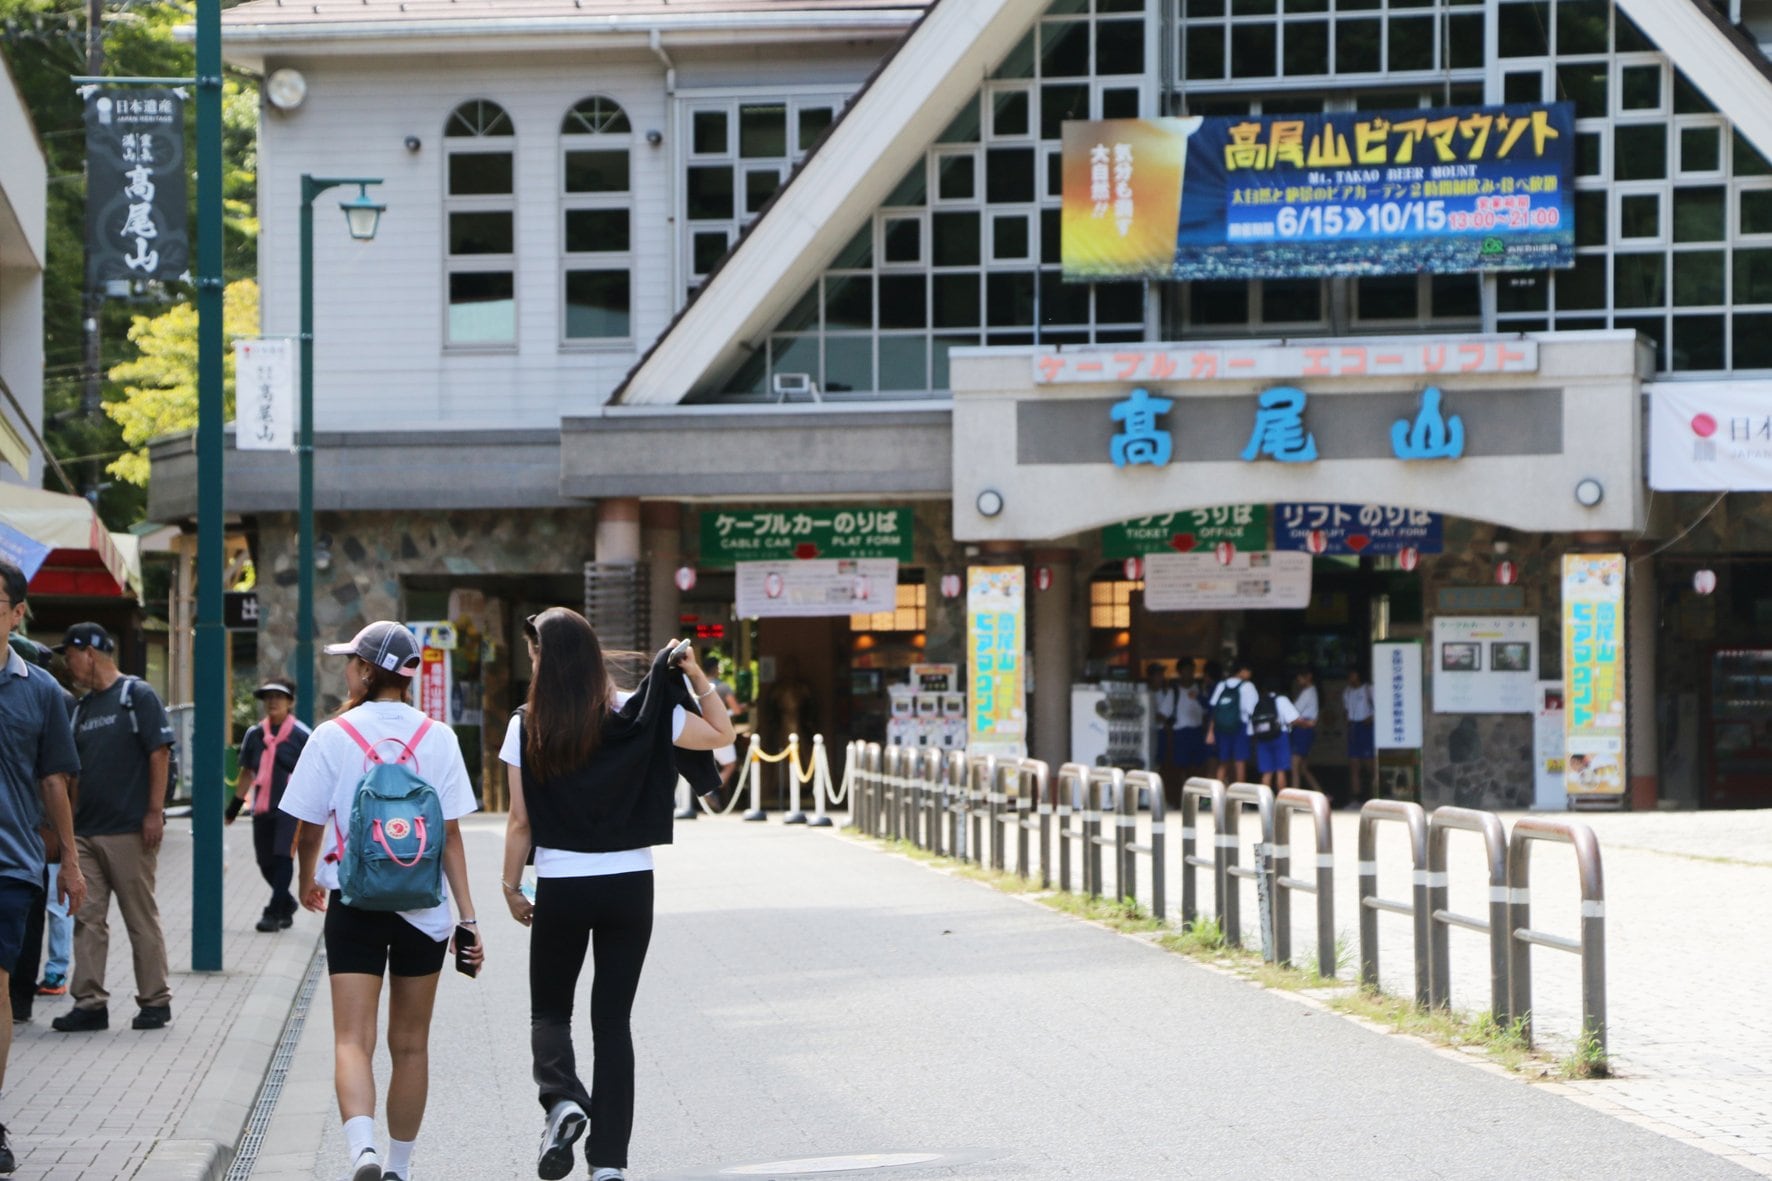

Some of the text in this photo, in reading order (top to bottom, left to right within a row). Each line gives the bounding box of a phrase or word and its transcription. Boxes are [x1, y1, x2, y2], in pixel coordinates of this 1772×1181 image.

[116, 99, 173, 115] 日本遺産
[1224, 111, 1559, 171] 高尾山ビアマウント
[1335, 169, 1381, 184] TAKAO
[1385, 167, 1425, 180] BEER
[1430, 165, 1477, 179] MOUNT
[120, 164, 160, 273] 高尾山
[1110, 387, 1465, 469] 高尾山
[715, 510, 898, 536] ケーブルカーのりば
[1127, 526, 1244, 539] TICKET OFFICE
[720, 537, 791, 549] CABLE CAR
[832, 535, 900, 546] PLAT FORM
